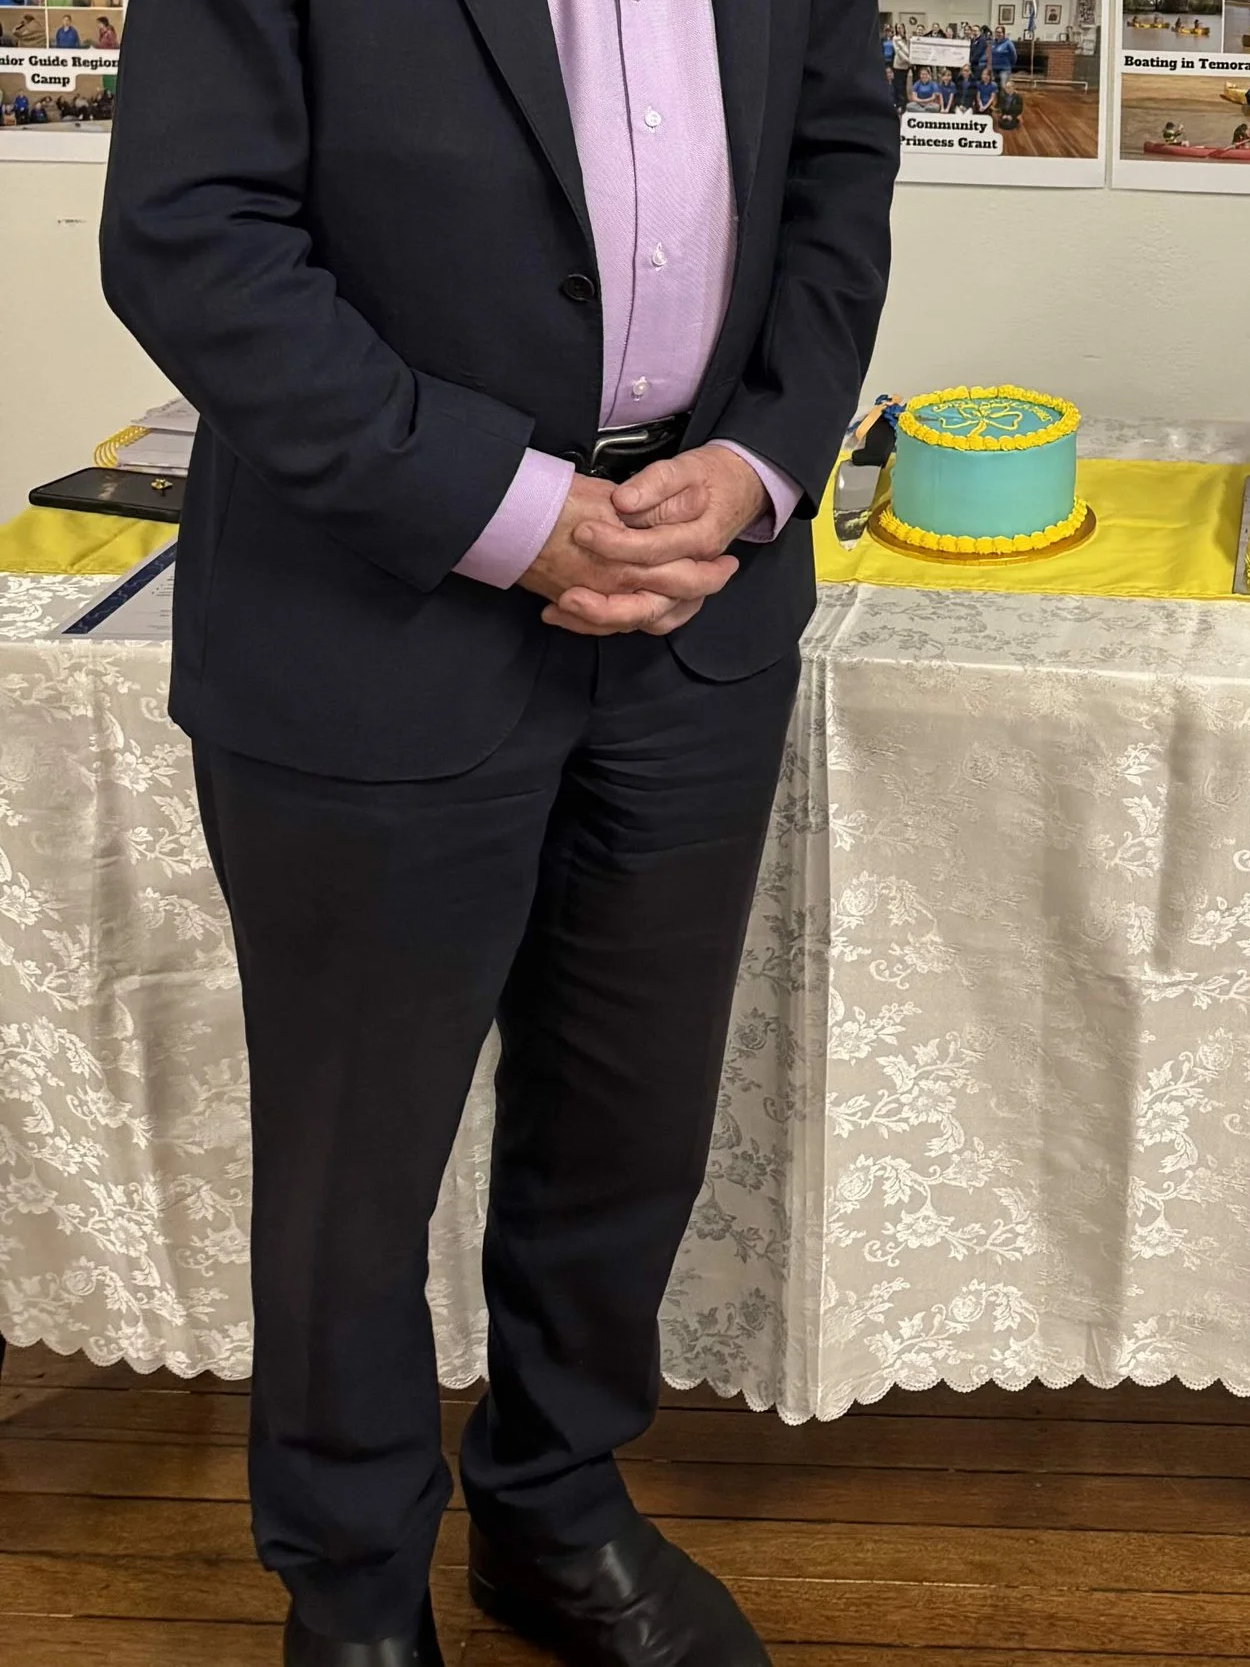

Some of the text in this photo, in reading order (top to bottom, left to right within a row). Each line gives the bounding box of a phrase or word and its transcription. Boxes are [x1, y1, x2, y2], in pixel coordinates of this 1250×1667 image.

[29, 56, 68, 67] Guide
[1125, 56, 1178, 69] Boating
[1180, 57, 1195, 69] in
[31, 74, 70, 87] Camp
[907, 118, 987, 133] Community
[958, 137, 998, 150] Grant
